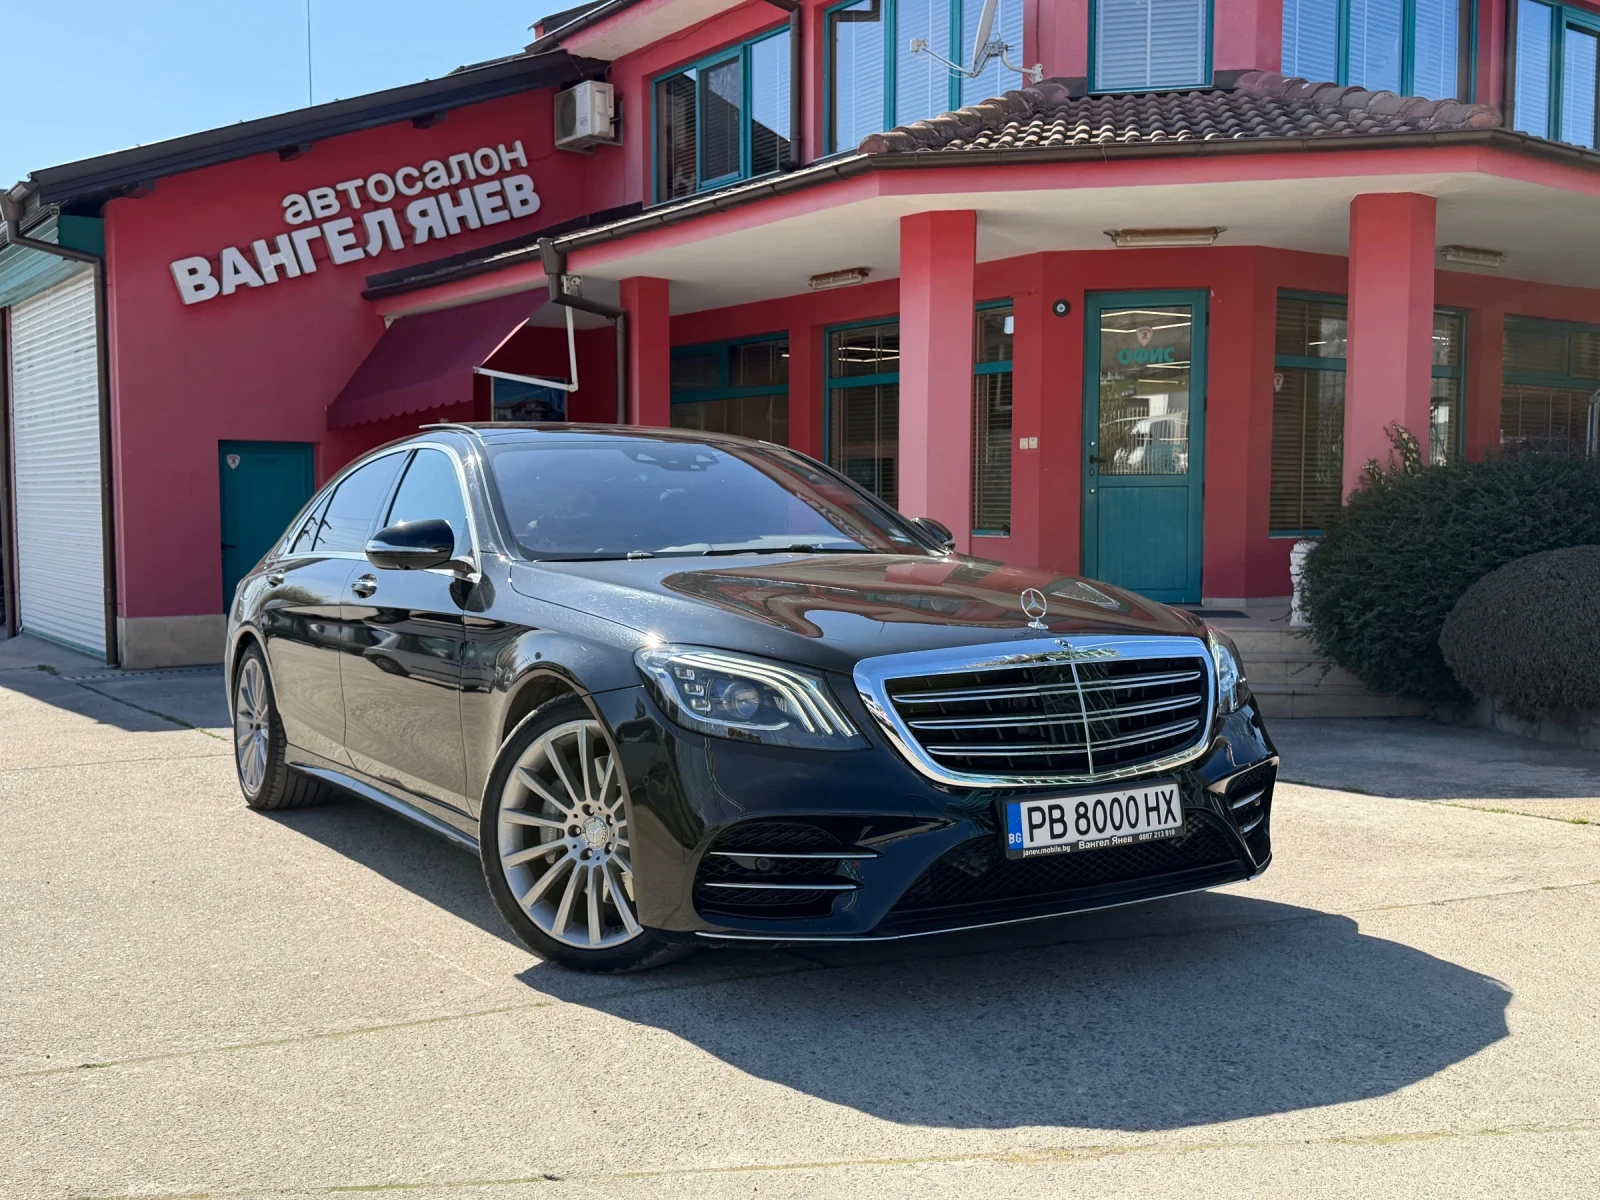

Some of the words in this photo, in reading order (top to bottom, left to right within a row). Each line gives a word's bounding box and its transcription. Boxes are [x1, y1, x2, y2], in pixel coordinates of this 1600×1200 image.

[170, 207, 405, 305] ВАНГЕЛ
[404, 173, 541, 245] ЯНЕВ
[1117, 347, 1175, 365] ОФИС
[1027, 804, 1068, 842] PB
[1075, 795, 1139, 836] 8000
[1144, 789, 1177, 826] HX
[1008, 832, 1022, 844] BG
[1078, 839, 1110, 850] Вангел
[1111, 835, 1133, 845] Янев
